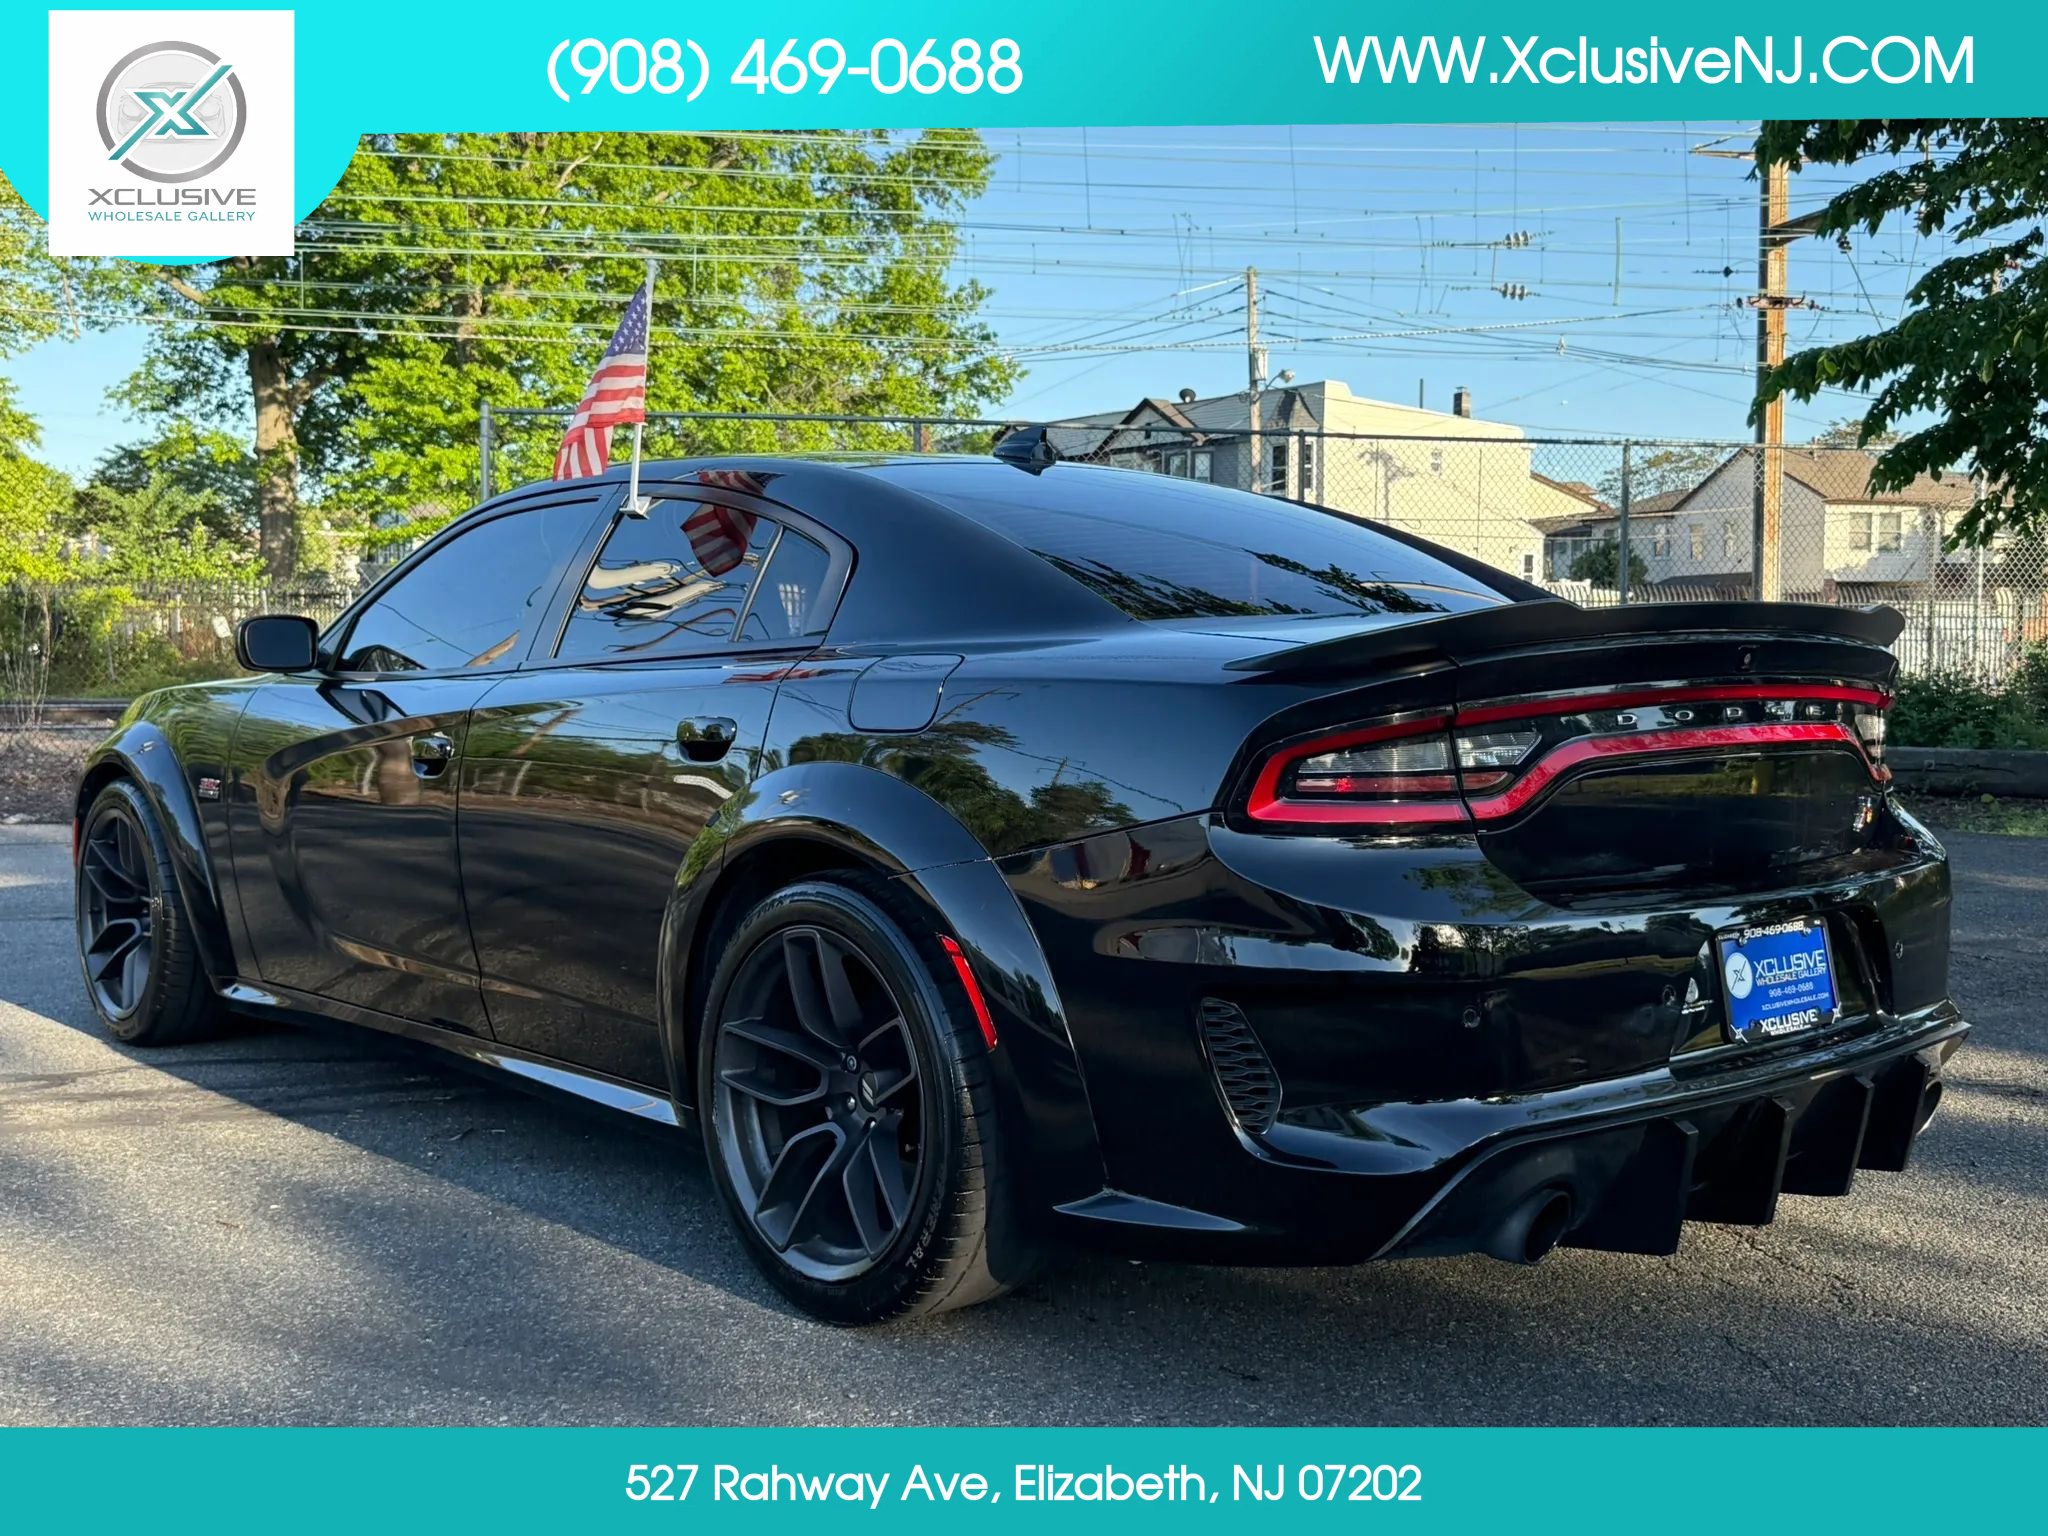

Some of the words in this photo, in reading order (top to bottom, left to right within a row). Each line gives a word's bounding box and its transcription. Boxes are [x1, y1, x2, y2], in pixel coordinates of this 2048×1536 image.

[1616, 702, 1826, 726] DODGE
[1743, 921, 1804, 939] 908-469-0688
[1753, 949, 1827, 978] XCLUSIVE
[1755, 970, 1797, 987] WHOLESALE
[1798, 966, 1827, 981] GALLERY
[1760, 1008, 1819, 1033] XCLUSIVE
